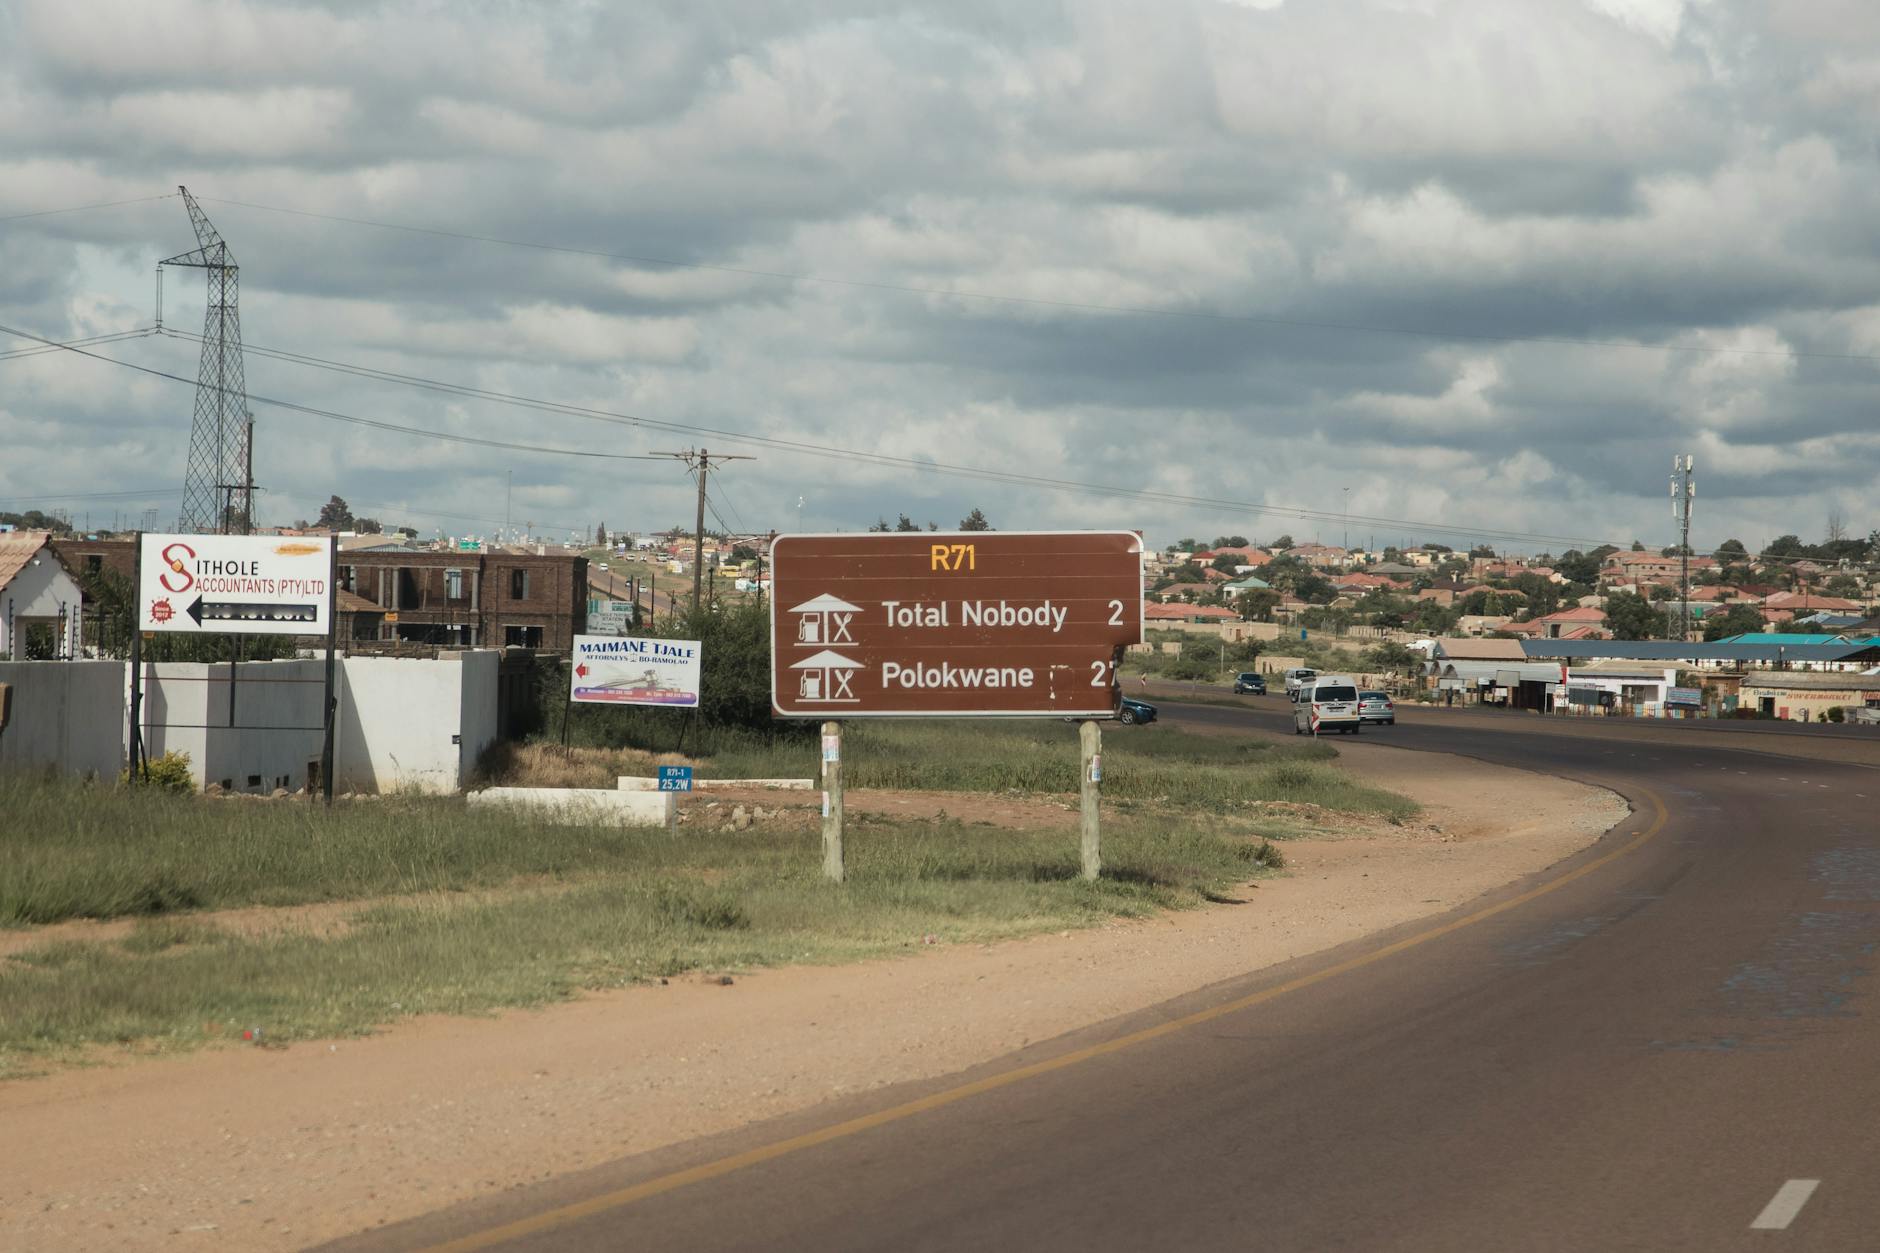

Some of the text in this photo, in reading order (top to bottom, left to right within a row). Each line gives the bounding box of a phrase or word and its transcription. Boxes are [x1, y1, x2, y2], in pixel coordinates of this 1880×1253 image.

[160, 543, 259, 593] SITHOLE
[931, 544, 976, 571] R71
[195, 578, 275, 593] ACCOUNTANTS
[881, 600, 1124, 633] Total Nobody 2
[580, 641, 695, 658] MAIMANE TJALE
[585, 654, 628, 662] ATTORNEYS
[881, 662, 1034, 689] Polokwane
[666, 768, 685, 777] R71-1
